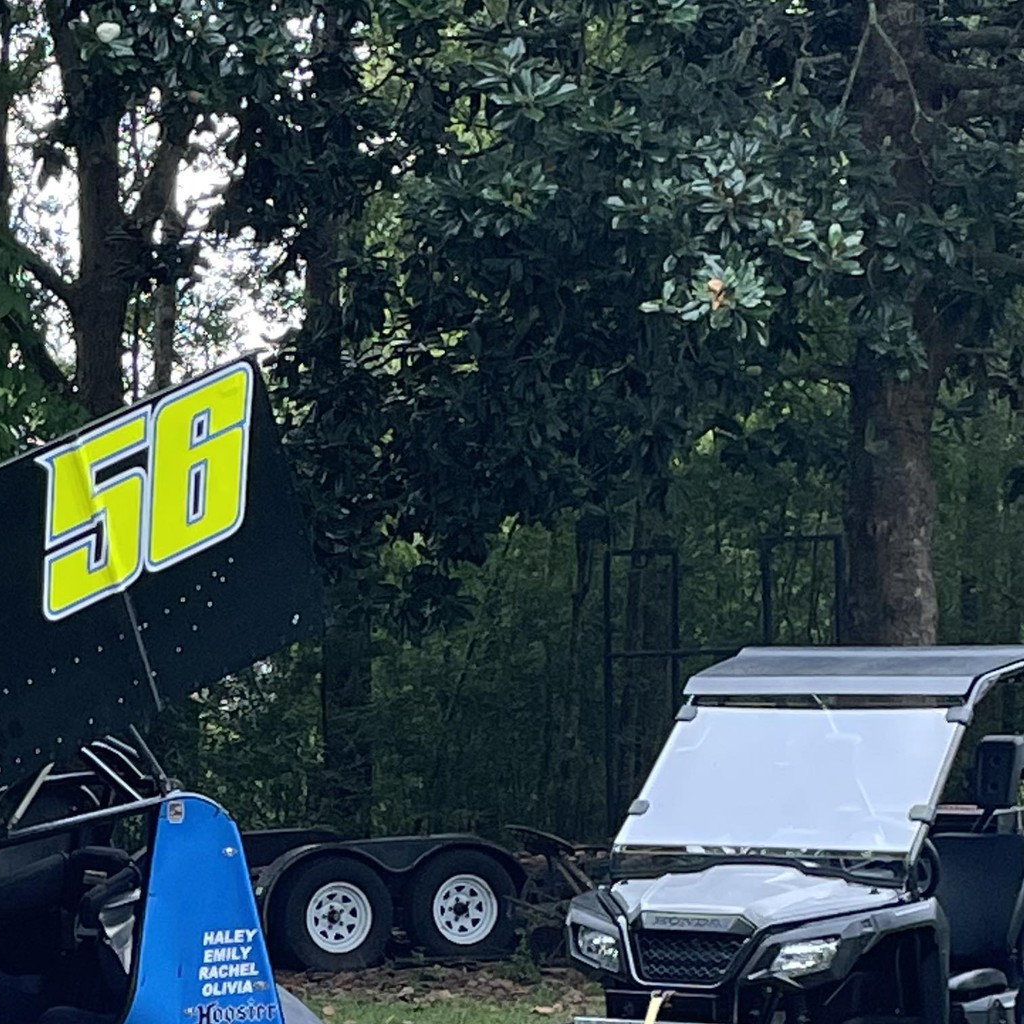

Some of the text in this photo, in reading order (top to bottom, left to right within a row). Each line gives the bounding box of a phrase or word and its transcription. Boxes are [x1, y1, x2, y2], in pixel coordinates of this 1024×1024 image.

[34, 361, 253, 621] 56
[654, 915, 724, 929] HONDA
[202, 927, 258, 946] HALEY
[203, 946, 252, 963] EMILY
[198, 962, 259, 980] RACHEL
[201, 980, 254, 997] OLIVIA
